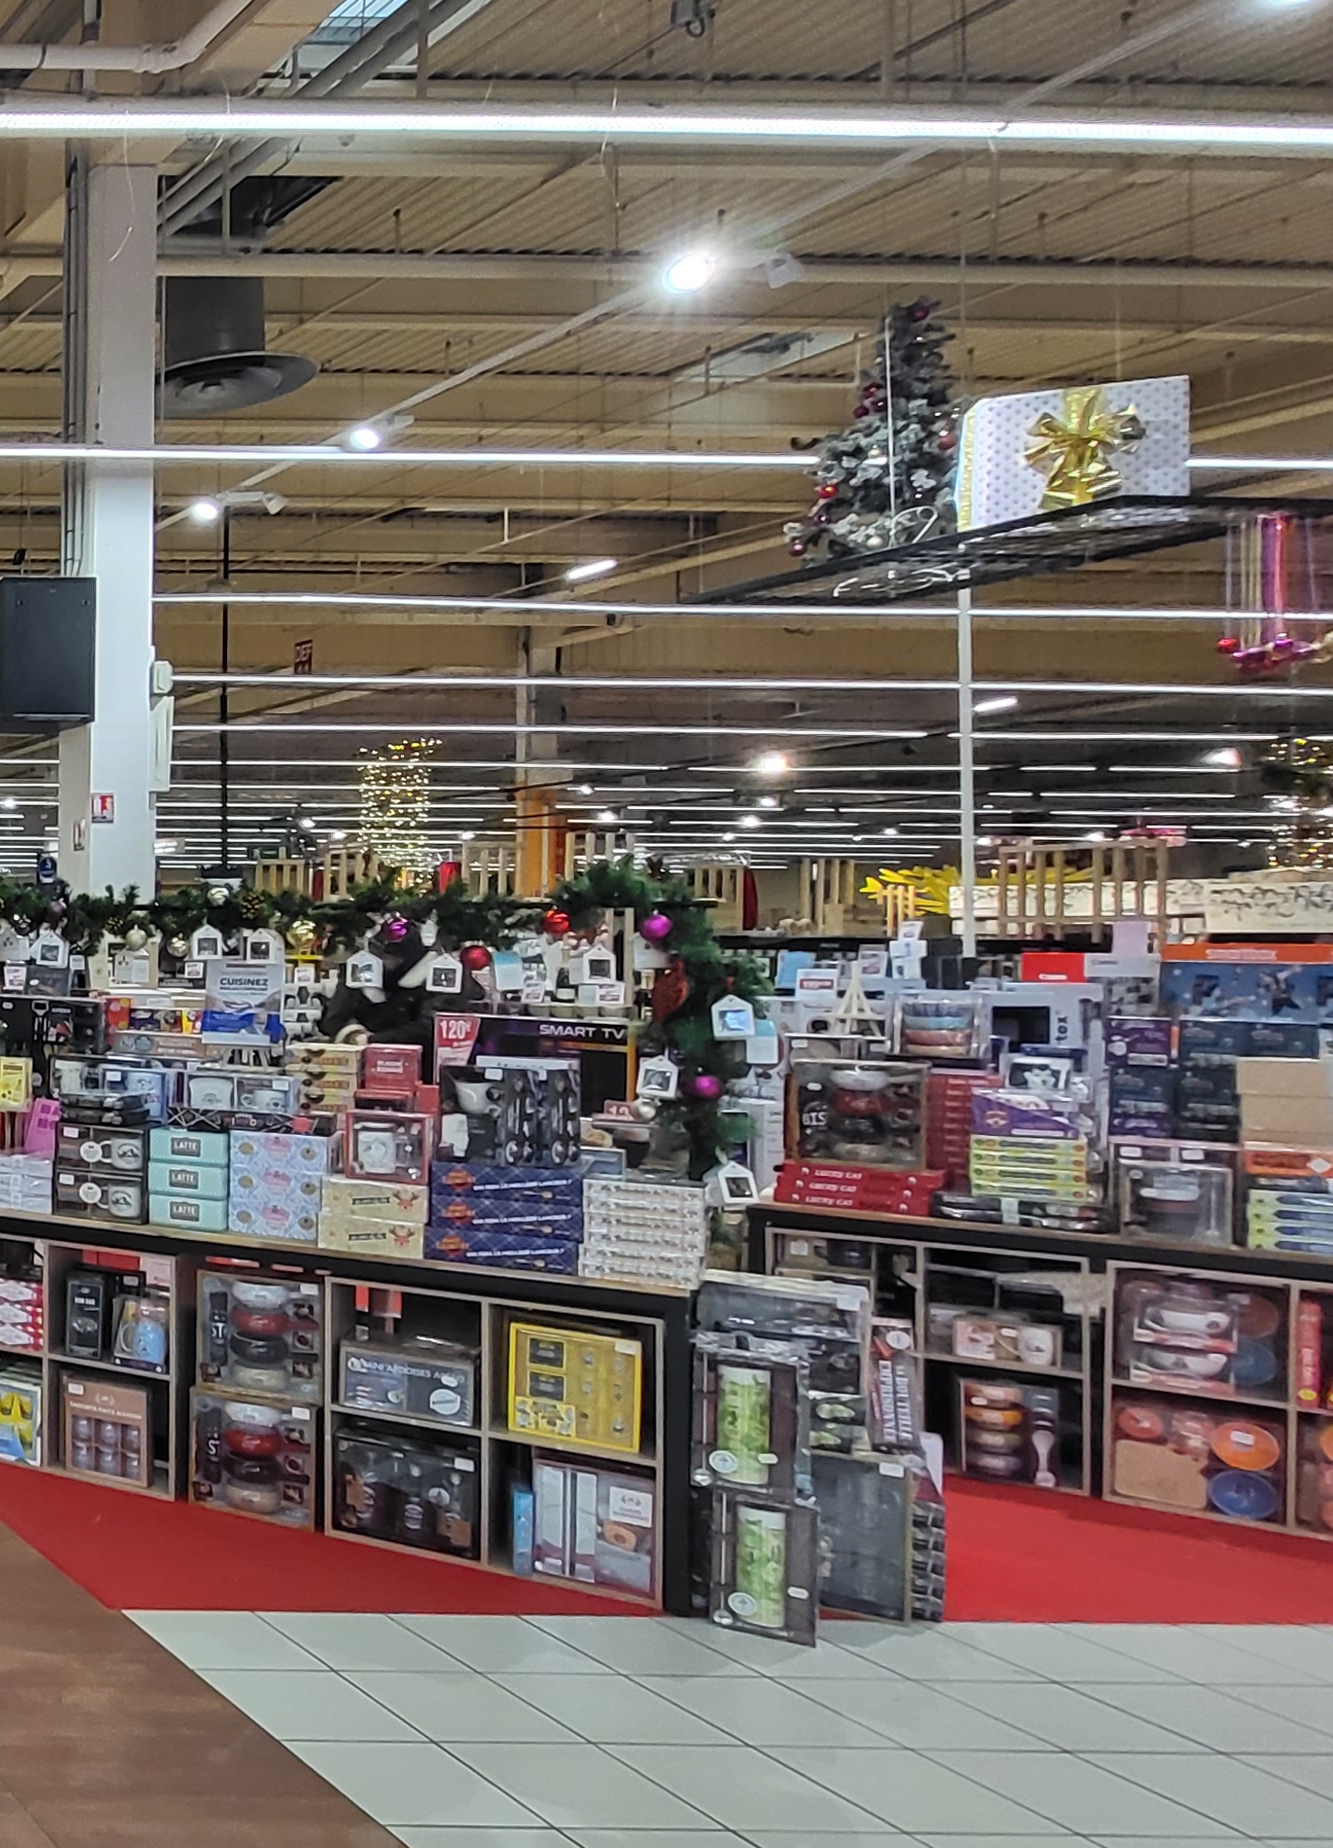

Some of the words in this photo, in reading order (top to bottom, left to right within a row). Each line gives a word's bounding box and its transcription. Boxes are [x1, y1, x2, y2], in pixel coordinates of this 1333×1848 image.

[220, 977, 269, 987] CUISINEZ
[539, 1023, 597, 1038] SMART
[602, 1028, 626, 1040] TV
[173, 1140, 199, 1151] LATTE
[171, 1172, 196, 1183] LATTE
[172, 1205, 198, 1216] LATTE
